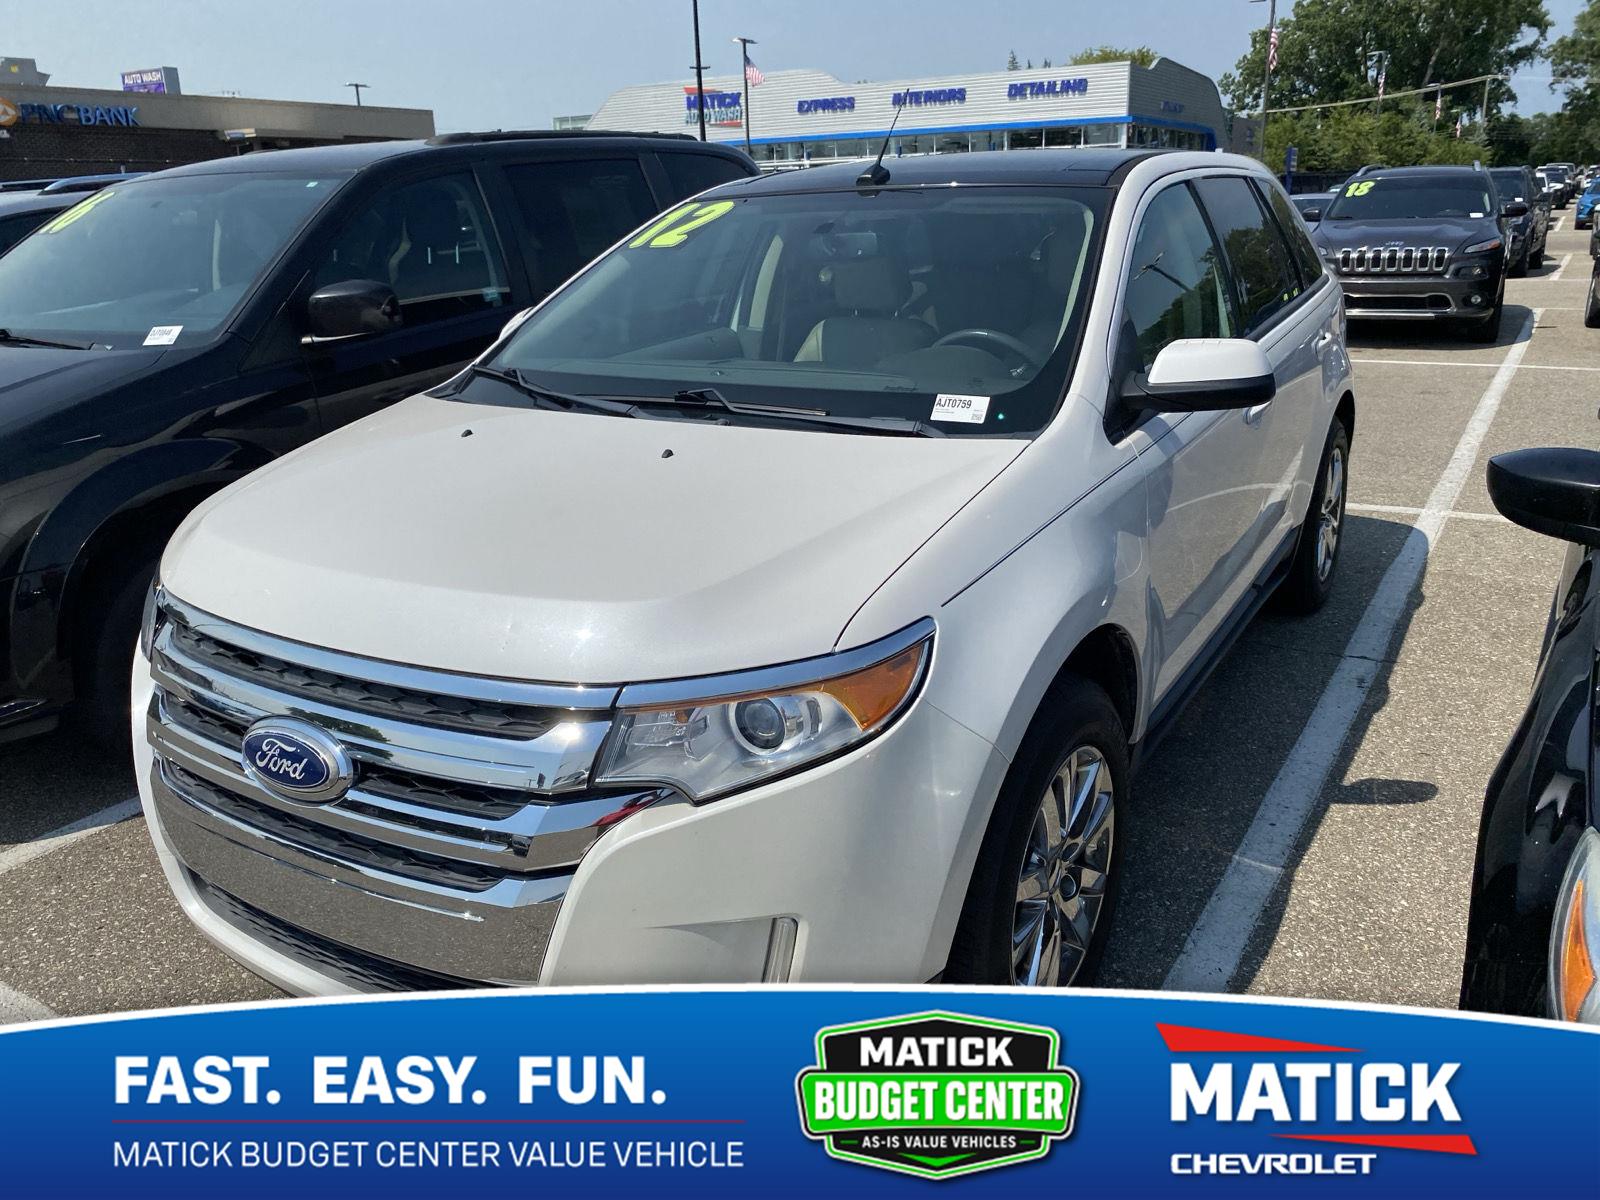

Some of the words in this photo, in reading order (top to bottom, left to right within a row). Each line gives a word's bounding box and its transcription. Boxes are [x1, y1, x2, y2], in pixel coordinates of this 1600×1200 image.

[124, 73, 142, 84] AUTO
[142, 71, 161, 82] WASH
[892, 87, 966, 107] INTERIORS
[1007, 78, 1088, 99] DETAILING
[20, 103, 79, 125] PNC
[79, 104, 139, 126] BANK
[797, 96, 855, 114] EXPRESS
[1345, 181, 1376, 198] 18
[628, 201, 735, 249] 12
[936, 398, 972, 409] AJT0759
[255, 738, 308, 780] Ford
